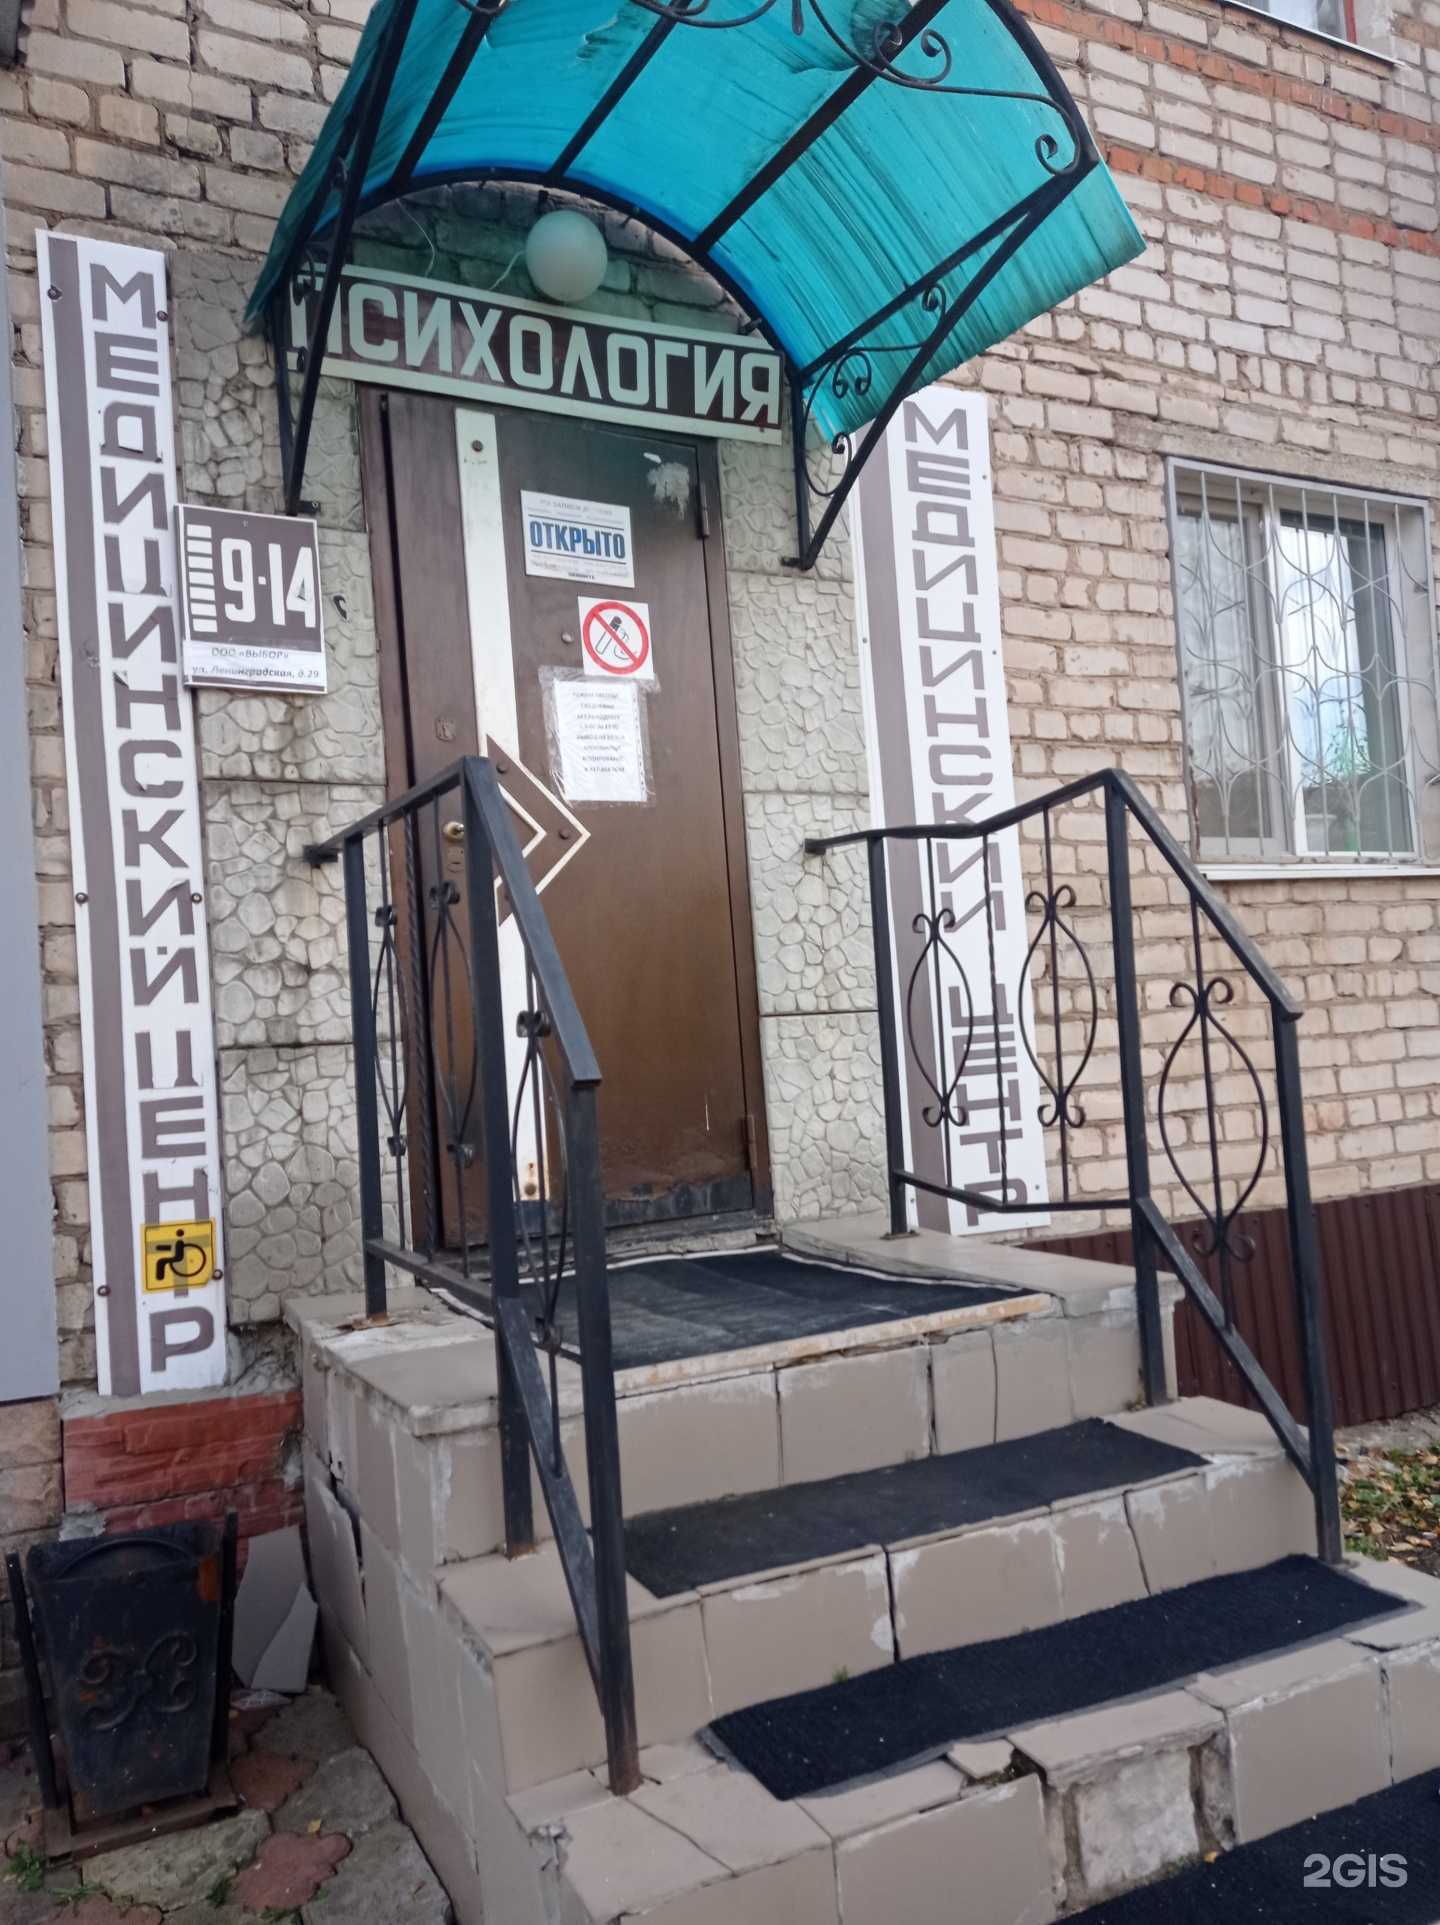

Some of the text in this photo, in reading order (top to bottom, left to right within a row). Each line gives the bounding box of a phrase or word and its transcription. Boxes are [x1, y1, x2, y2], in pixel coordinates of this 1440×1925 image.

[289, 272, 783, 426] ПСИХОЛОГИЯ
[529, 521, 626, 559] ОТКРЫТО
[211, 647, 236, 657] ООО
[948, 983, 1028, 1227] ЦЕНТР
[134, 1030, 214, 1373] ЦЕНТР
